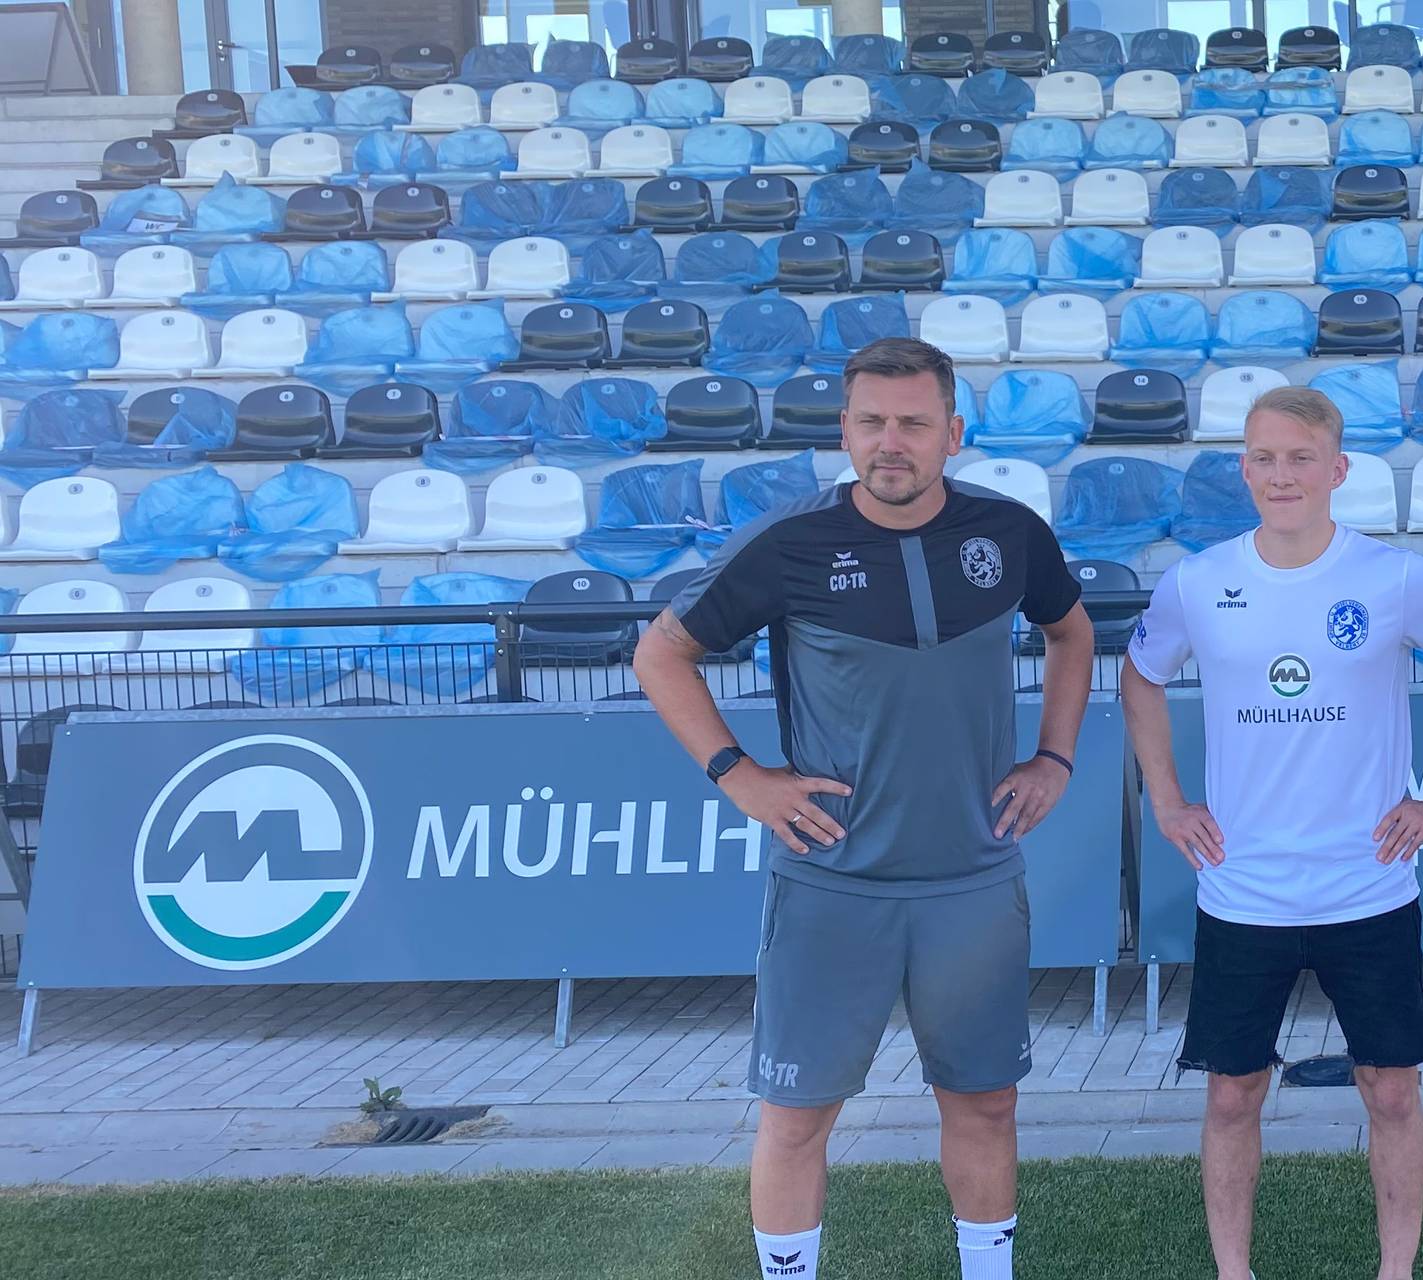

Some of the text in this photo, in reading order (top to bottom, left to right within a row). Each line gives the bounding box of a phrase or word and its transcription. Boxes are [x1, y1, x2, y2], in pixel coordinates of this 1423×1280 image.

[831, 558, 859, 569] erima
[1216, 600, 1247, 609] erima
[1237, 706, 1346, 724] MÜHLHAUSE
[407, 787, 763, 879] MÜHLH
[766, 1263, 806, 1276] erima
